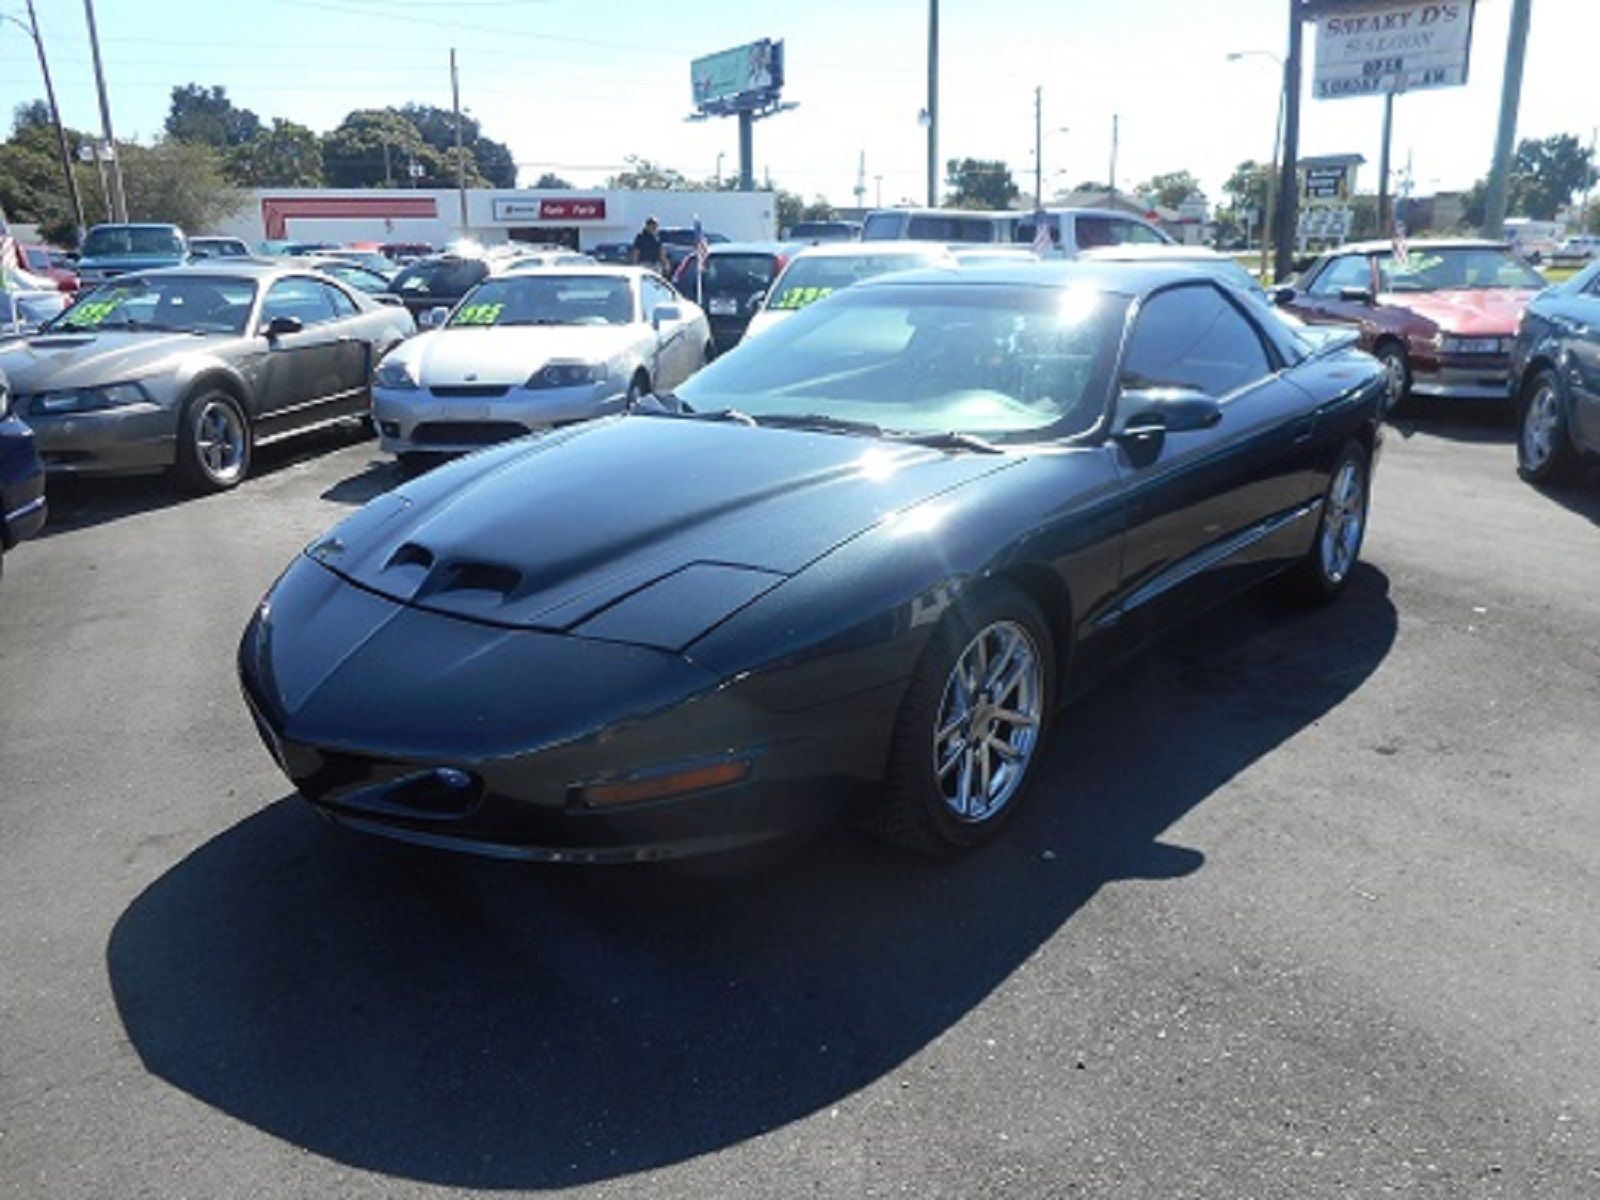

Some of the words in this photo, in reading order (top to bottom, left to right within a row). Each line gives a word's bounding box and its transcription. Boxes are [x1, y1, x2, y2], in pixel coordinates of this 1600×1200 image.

[1326, 12, 1412, 36] SNEAKY
[1419, 5, 1460, 27] D'S
[1363, 57, 1403, 76] OPEN
